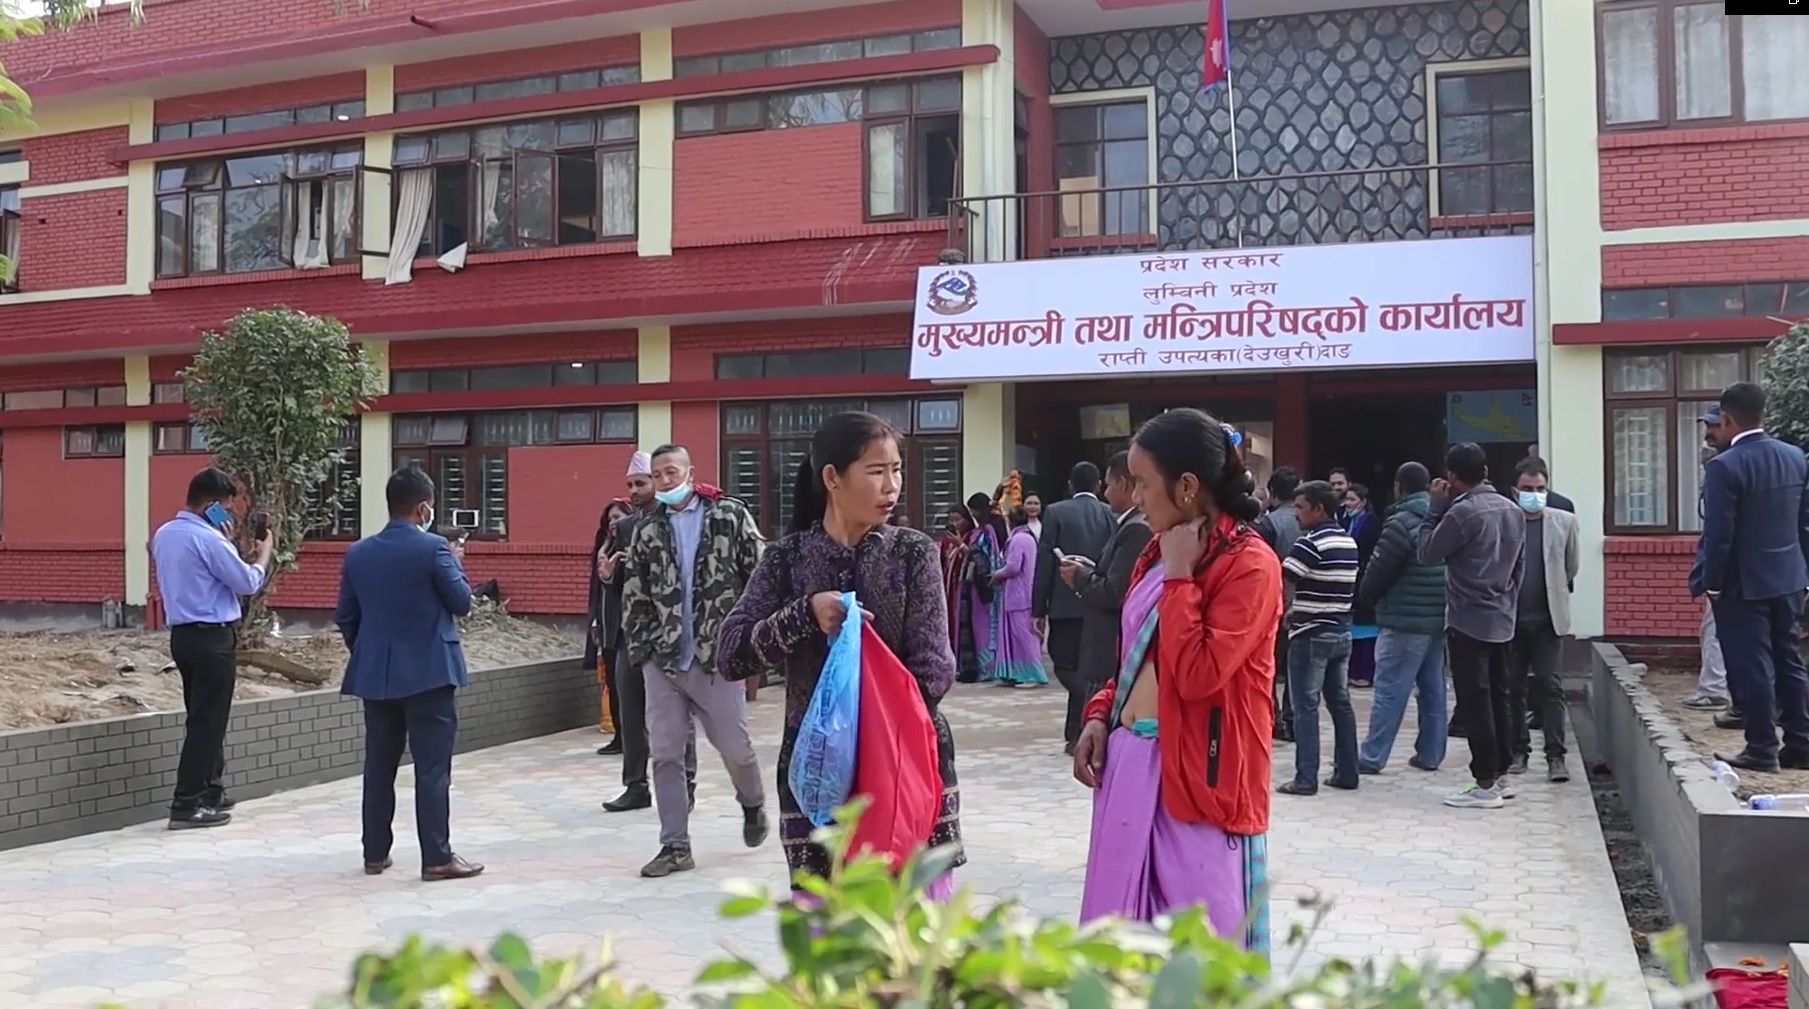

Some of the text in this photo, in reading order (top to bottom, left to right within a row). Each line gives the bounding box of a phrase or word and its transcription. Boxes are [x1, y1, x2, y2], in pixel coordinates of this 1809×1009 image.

[1140, 253, 1283, 274] प्रदेश सरकार
[1143, 280, 1278, 305] लुम्बिनी प्रदेश
[917, 293, 1526, 357] मुख्यमन्त्री तथा मन्त्रिपरिषद्को कार्यालय
[1099, 347, 1147, 368] राप्ती
